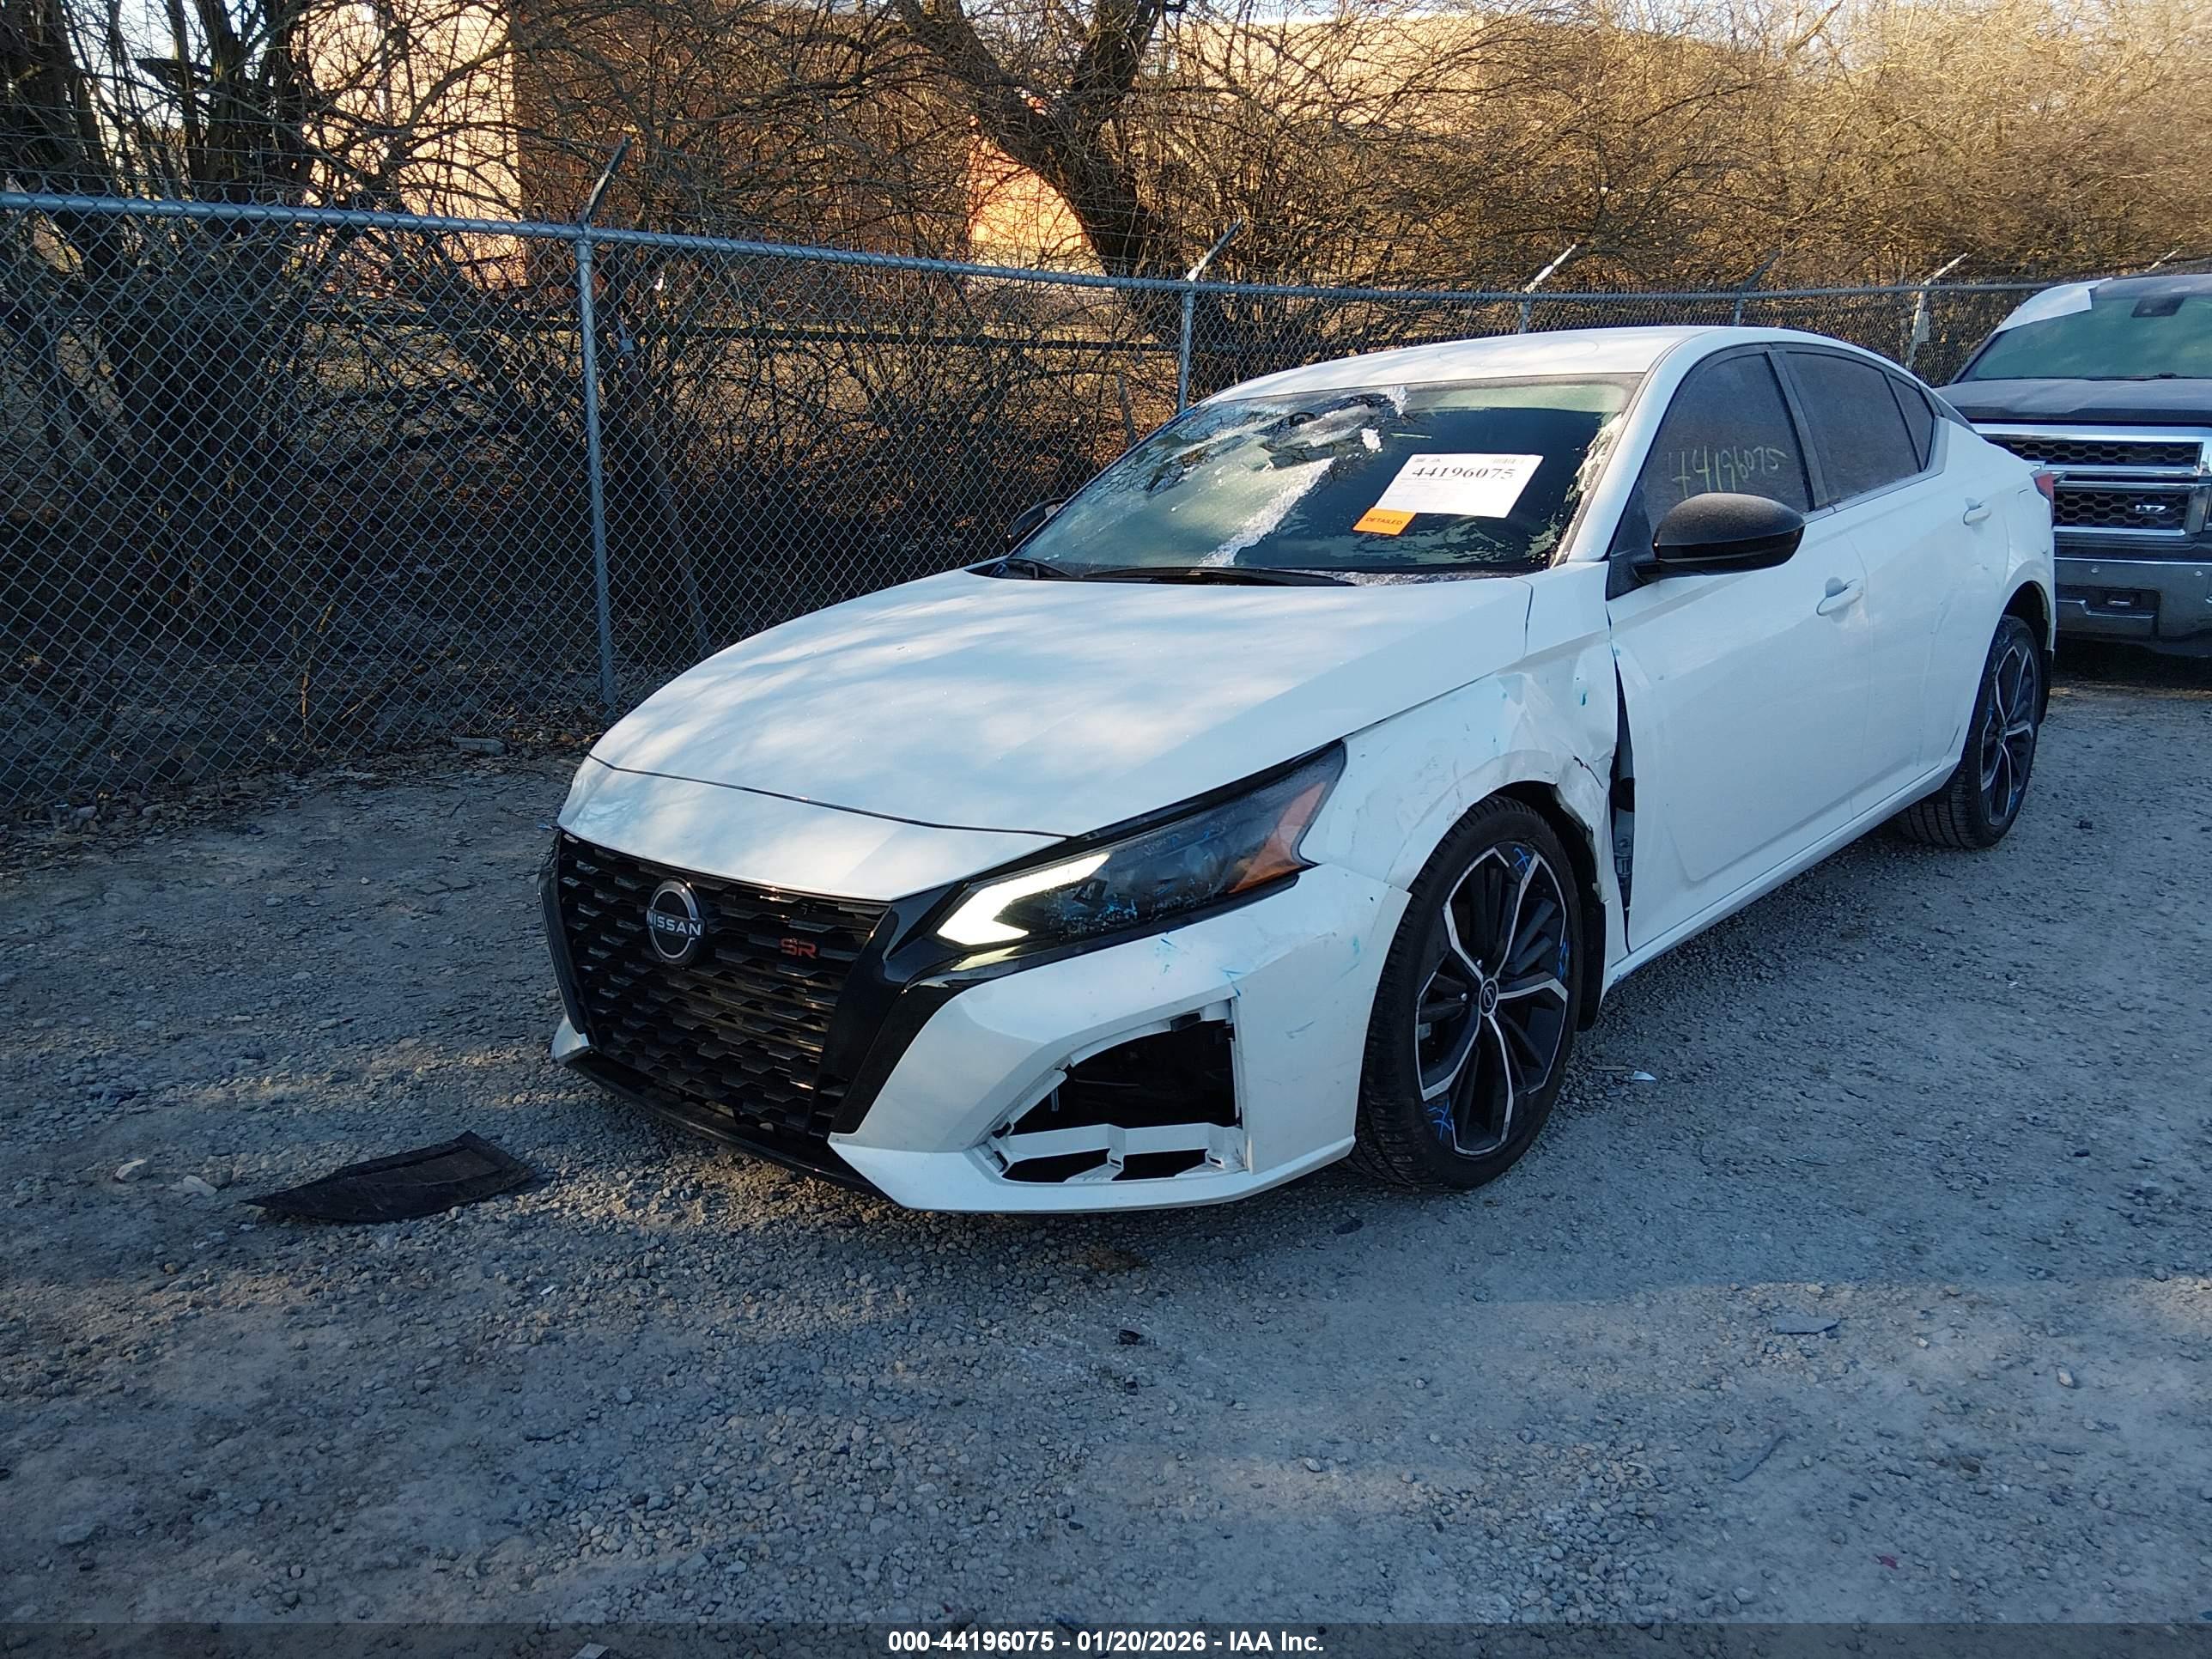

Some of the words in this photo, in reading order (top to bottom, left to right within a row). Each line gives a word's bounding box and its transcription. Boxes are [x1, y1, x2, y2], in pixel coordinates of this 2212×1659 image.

[1412, 466, 1516, 480] 44196075
[1365, 517, 1403, 526] DETAILED
[647, 908, 702, 937] NISSAN
[780, 938, 817, 959] SR
